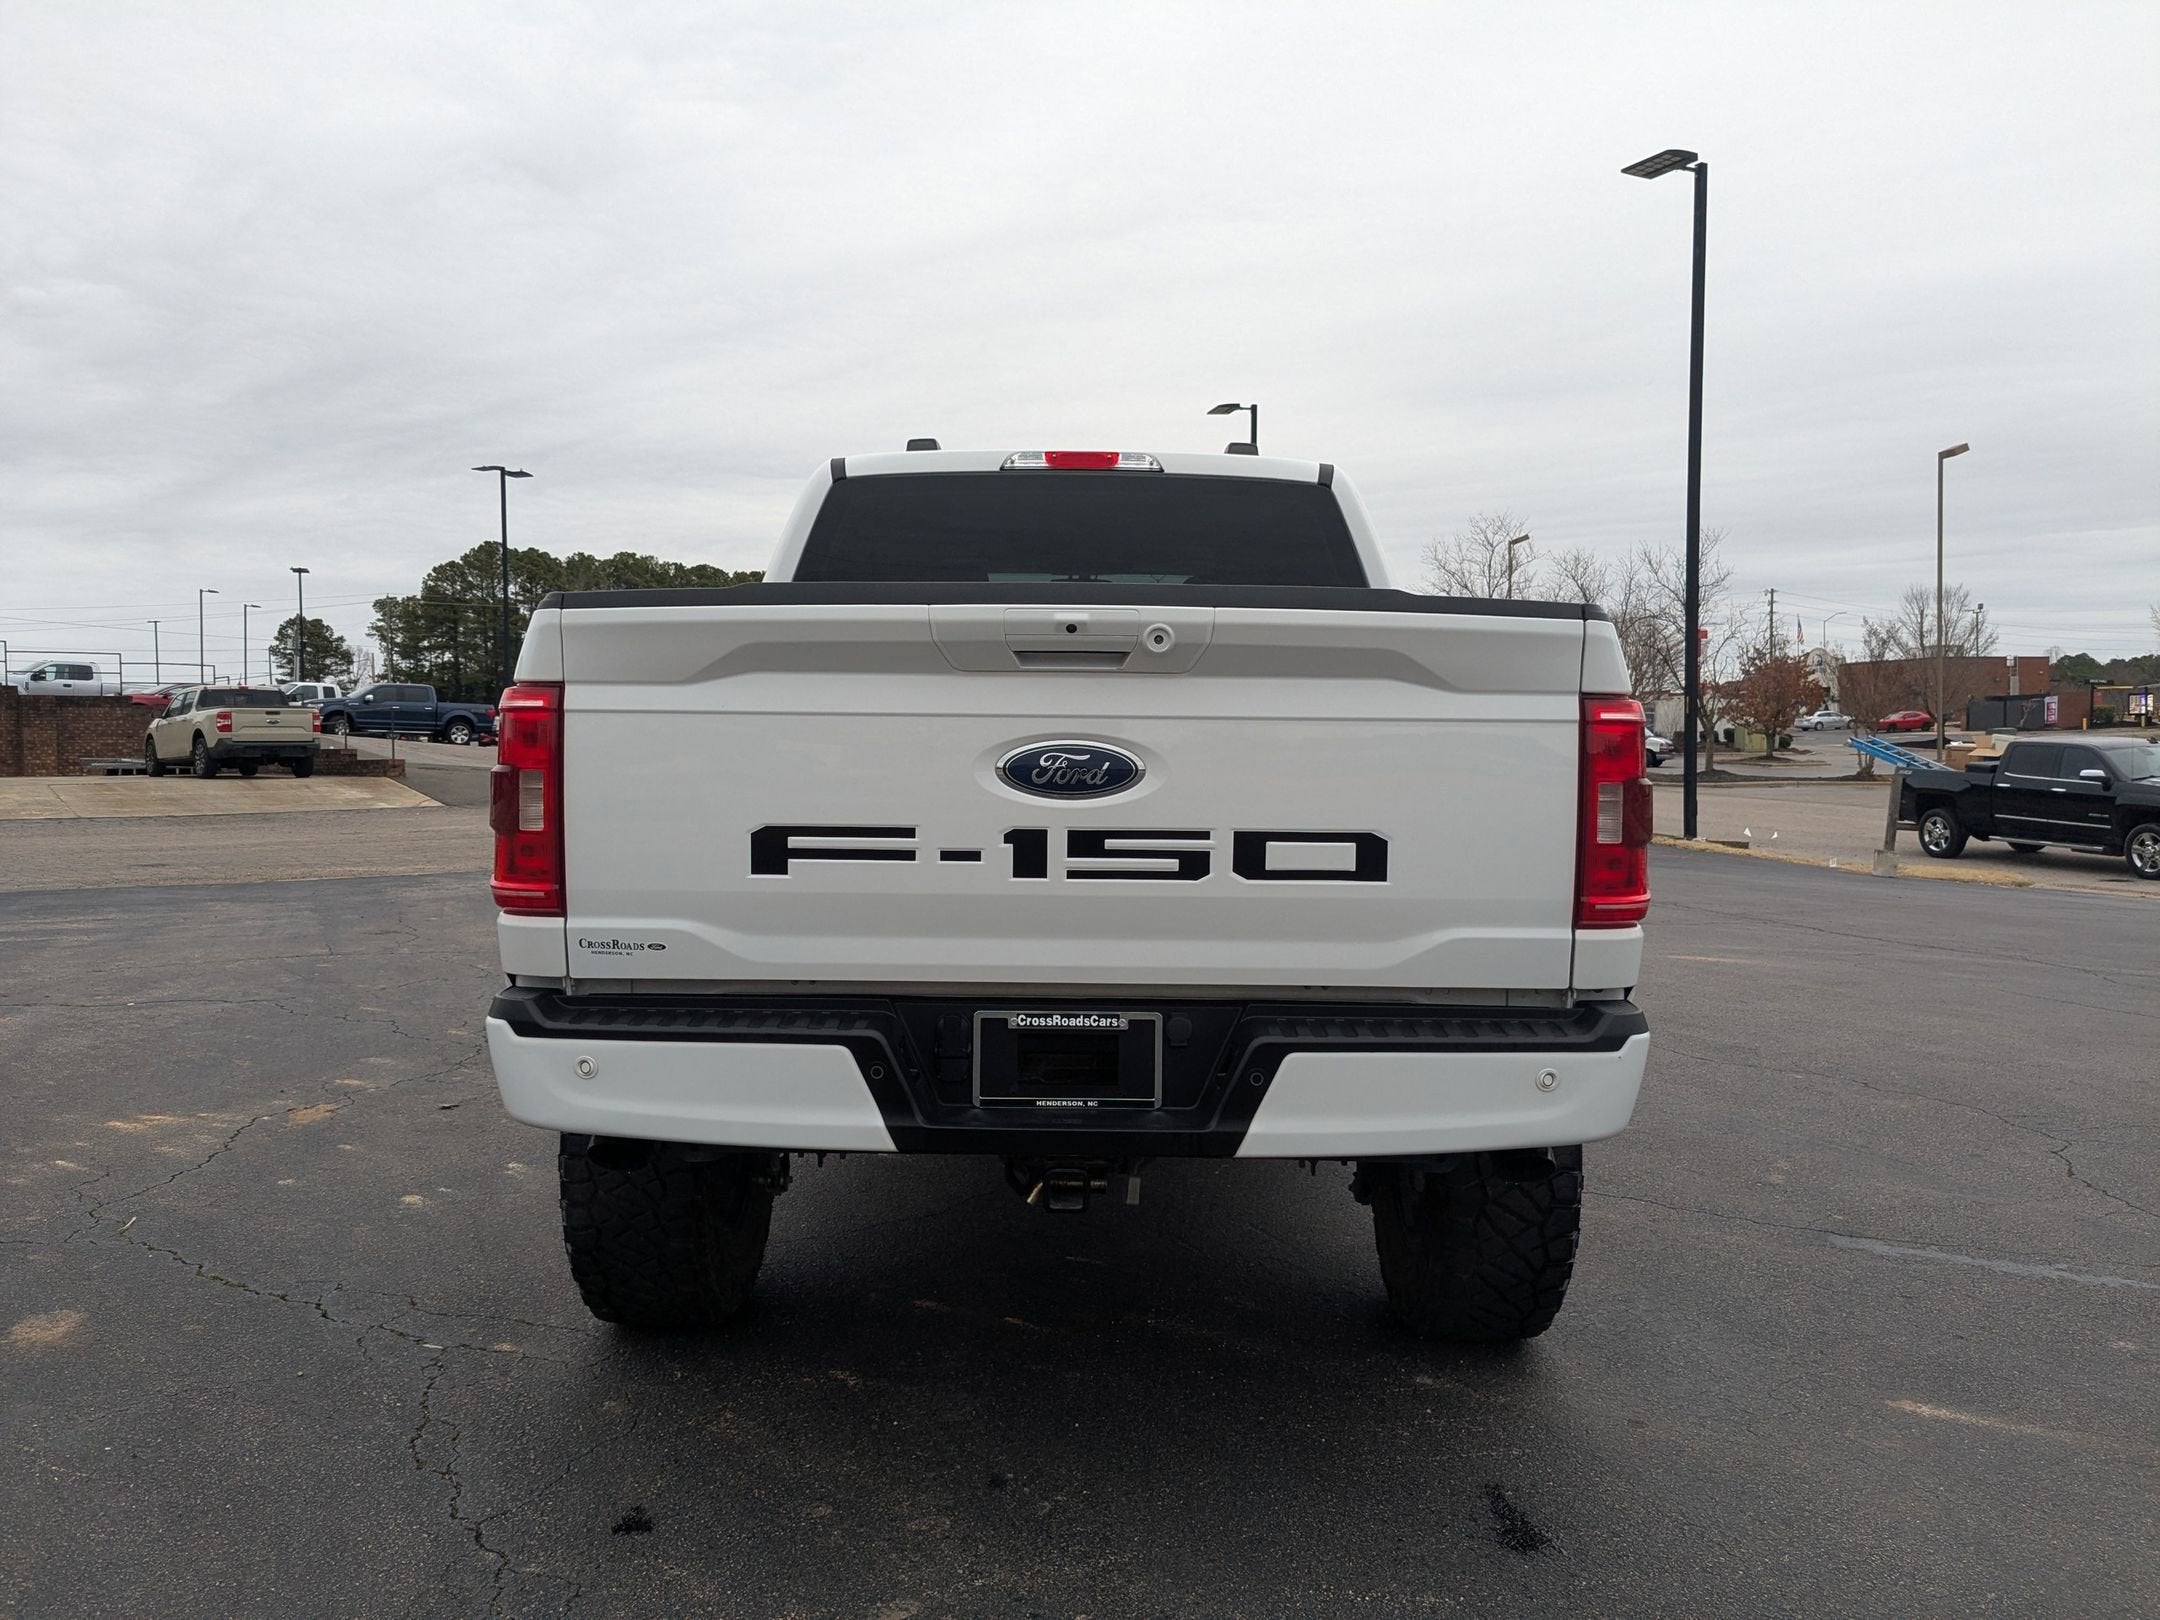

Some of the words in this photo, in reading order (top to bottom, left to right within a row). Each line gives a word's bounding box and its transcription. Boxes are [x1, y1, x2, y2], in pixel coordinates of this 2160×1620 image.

[1031, 752, 1110, 785] Ford
[748, 824, 1389, 883] F-150
[1018, 1014, 1118, 1026] CrossRoadsCars
[1036, 1100, 1086, 1108] HENDERSON,
